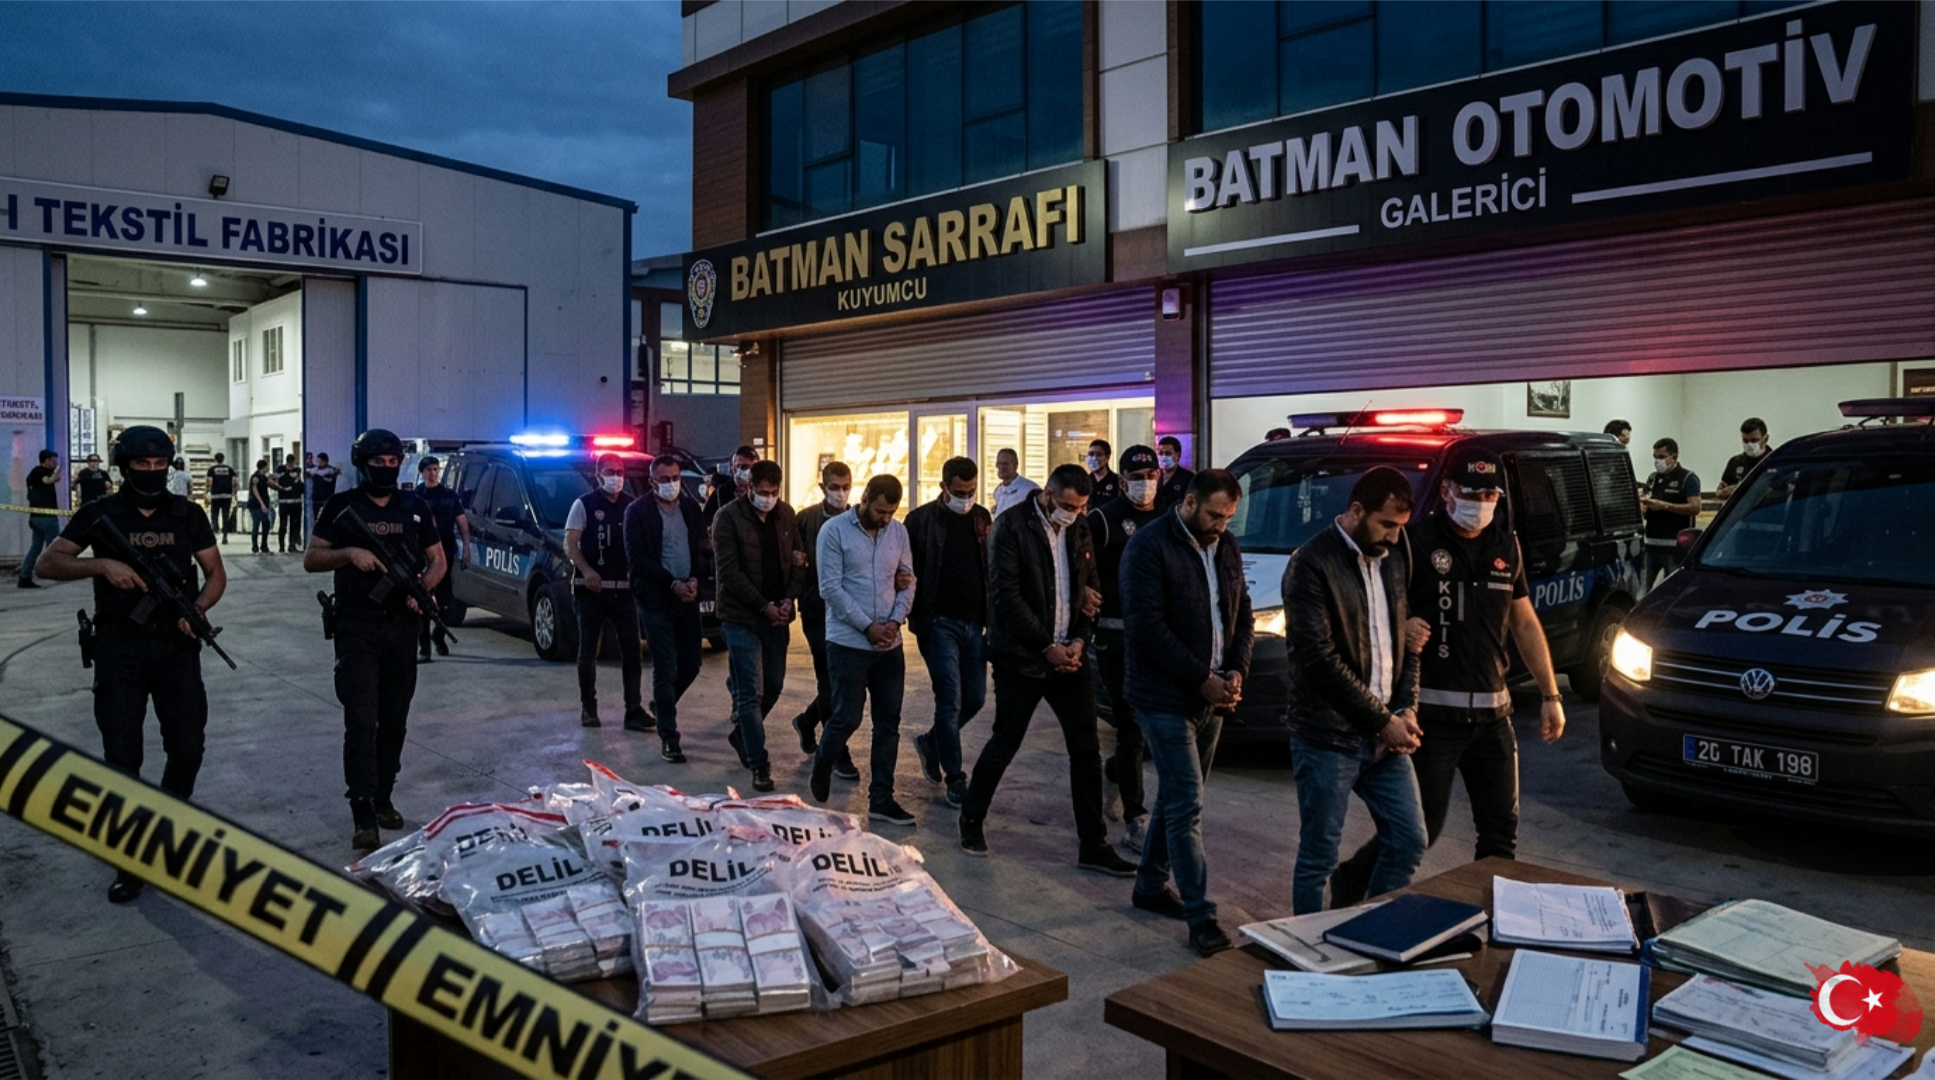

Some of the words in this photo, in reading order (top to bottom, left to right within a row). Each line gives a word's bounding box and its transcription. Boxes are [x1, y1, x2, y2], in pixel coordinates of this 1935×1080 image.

[1184, 115, 1418, 213] BATMAN
[1452, 19, 1877, 166] OTOMOTİV
[1381, 167, 1546, 229] GALERİCİ
[34, 197, 208, 247] TEKSTİL
[222, 217, 409, 265] FABRİKASI
[731, 228, 872, 301] BATMAN
[882, 185, 1083, 274] SARRAFI
[838, 277, 927, 311] KUYUMCU
[485, 546, 520, 575] POLİS
[1534, 571, 1585, 609] POLİS
[1694, 610, 1882, 643] POLİS
[1731, 745, 1765, 770] TAK
[1777, 752, 1812, 776] 198
[50, 773, 347, 946] EMNİYET
[496, 857, 583, 891] DELİL
[670, 858, 756, 882] DELİL
[812, 852, 888, 877] DELİL
[416, 953, 695, 1080] EMNİY
